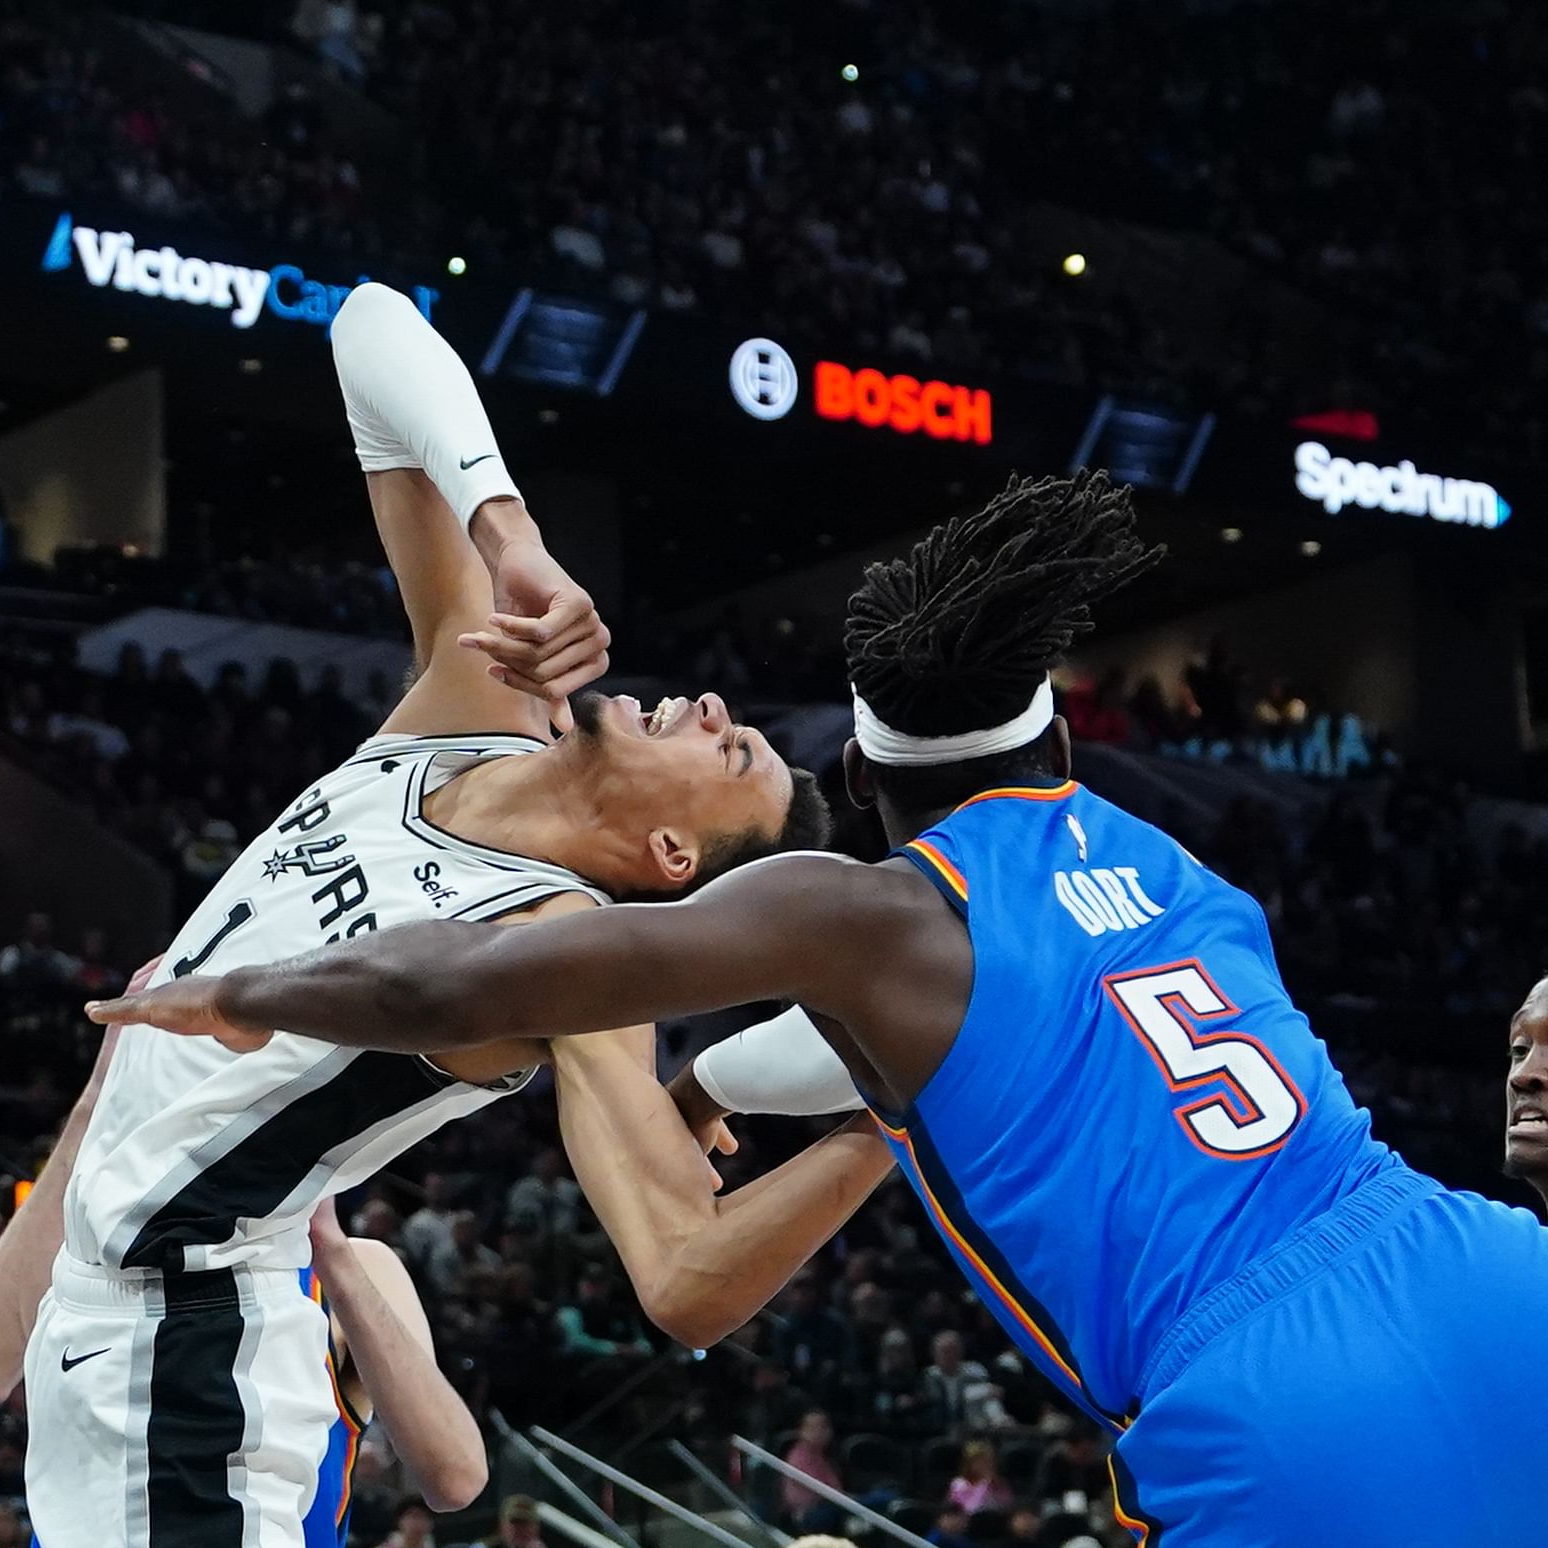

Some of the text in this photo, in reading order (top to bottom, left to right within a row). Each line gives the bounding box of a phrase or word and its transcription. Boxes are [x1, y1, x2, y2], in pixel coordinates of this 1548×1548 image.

[814, 360, 993, 446] BOSCH
[1294, 440, 1502, 530] Spectrum
[1103, 957, 1309, 1162] 5
